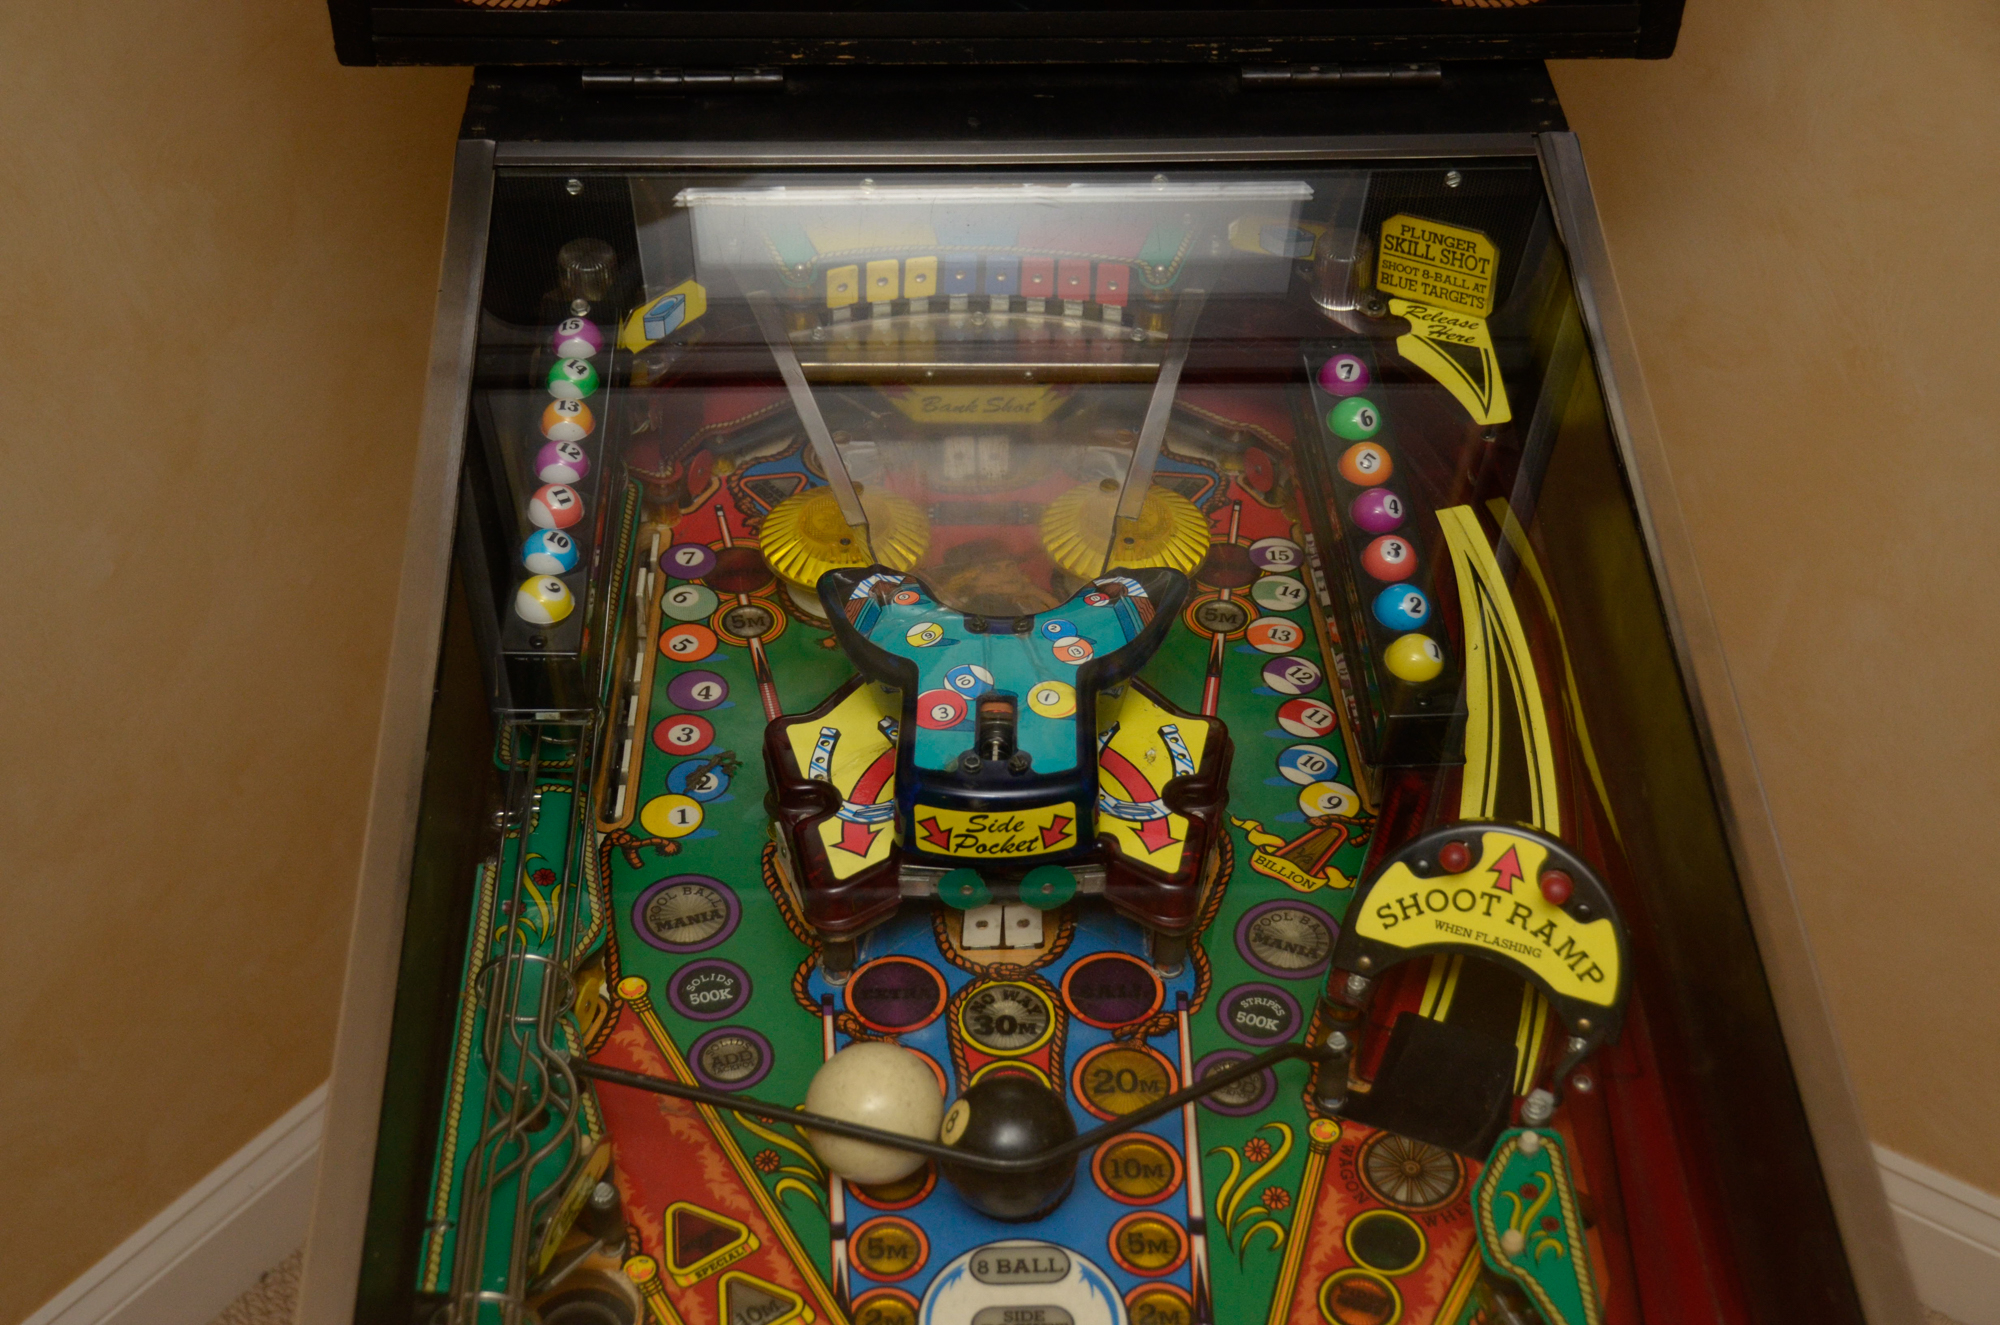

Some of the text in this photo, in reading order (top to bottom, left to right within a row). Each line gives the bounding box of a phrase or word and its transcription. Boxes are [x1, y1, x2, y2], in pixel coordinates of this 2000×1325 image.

[1400, 224, 1477, 254] PLUNGER
[1384, 234, 1490, 275] SKILL SHOT
[1382, 259, 1487, 294] SHOOT 8-BALL AT
[1380, 272, 1485, 309] BLUE TARGETS
[560, 319, 580, 332] 15
[1403, 305, 1479, 330] Release
[1427, 324, 1475, 344] Here
[566, 359, 588, 376] 14
[1340, 364, 1354, 379] 7
[557, 400, 580, 412] 13
[921, 396, 1037, 413] Bank Shot
[1361, 409, 1373, 426] 6
[558, 442, 581, 460] 12
[1359, 453, 1377, 470] 5
[551, 488, 570, 505] 11
[1388, 498, 1399, 514] 4
[547, 531, 569, 548] 10
[682, 551, 696, 564] 7
[1269, 550, 1290, 561] 15
[1386, 543, 1402, 559] 3
[545, 581, 562, 594] 9
[1280, 585, 1301, 599] 14
[673, 591, 692, 603] 6
[1408, 596, 1422, 614] 2
[731, 615, 766, 629] 5M
[1204, 608, 1238, 624] 5M
[1270, 628, 1292, 642] 13
[672, 638, 693, 651] 5
[1070, 646, 1082, 656] 13
[1430, 645, 1440, 659] 1
[957, 676, 970, 687] 10
[1289, 668, 1313, 684] 12
[698, 685, 712, 700] 4
[938, 707, 949, 719] 3
[1305, 709, 1329, 725] 11
[676, 727, 694, 742] 3
[1300, 755, 1325, 772] 10
[696, 774, 712, 790] 2
[1327, 796, 1342, 810] 9
[677, 808, 689, 825] 1
[966, 814, 1024, 833] Side
[953, 834, 1040, 854] Pocket
[1254, 855, 1316, 889] BILLION
[650, 886, 724, 922] POOL BALL
[654, 909, 724, 932] MANIA
[1253, 912, 1294, 933] POOL
[1376, 888, 1605, 984] SHOOT RAMP
[1434, 919, 1543, 960] WHEN FLASHING
[1251, 931, 1320, 959] MANIA
[686, 973, 734, 992] SOLIDS
[689, 988, 734, 1006] 500K
[969, 989, 1044, 1016] NO WAY
[1239, 997, 1286, 1017] STRIPES
[973, 1014, 1038, 1037] 30M
[1235, 1010, 1281, 1031] 500K
[711, 1050, 754, 1068] ADD
[1092, 1068, 1161, 1095] 20M
[946, 1110, 959, 1133] 8
[1111, 1157, 1164, 1180] 10M
[1338, 1144, 1370, 1205] WAGON
[867, 1238, 909, 1260] 5M
[1127, 1233, 1169, 1255] 5M
[695, 1246, 748, 1279] SPECIAL!
[977, 1258, 1064, 1275] 8 BALL
[1004, 1309, 1045, 1323] SIDE
[1138, 1303, 1181, 1325] 2M
